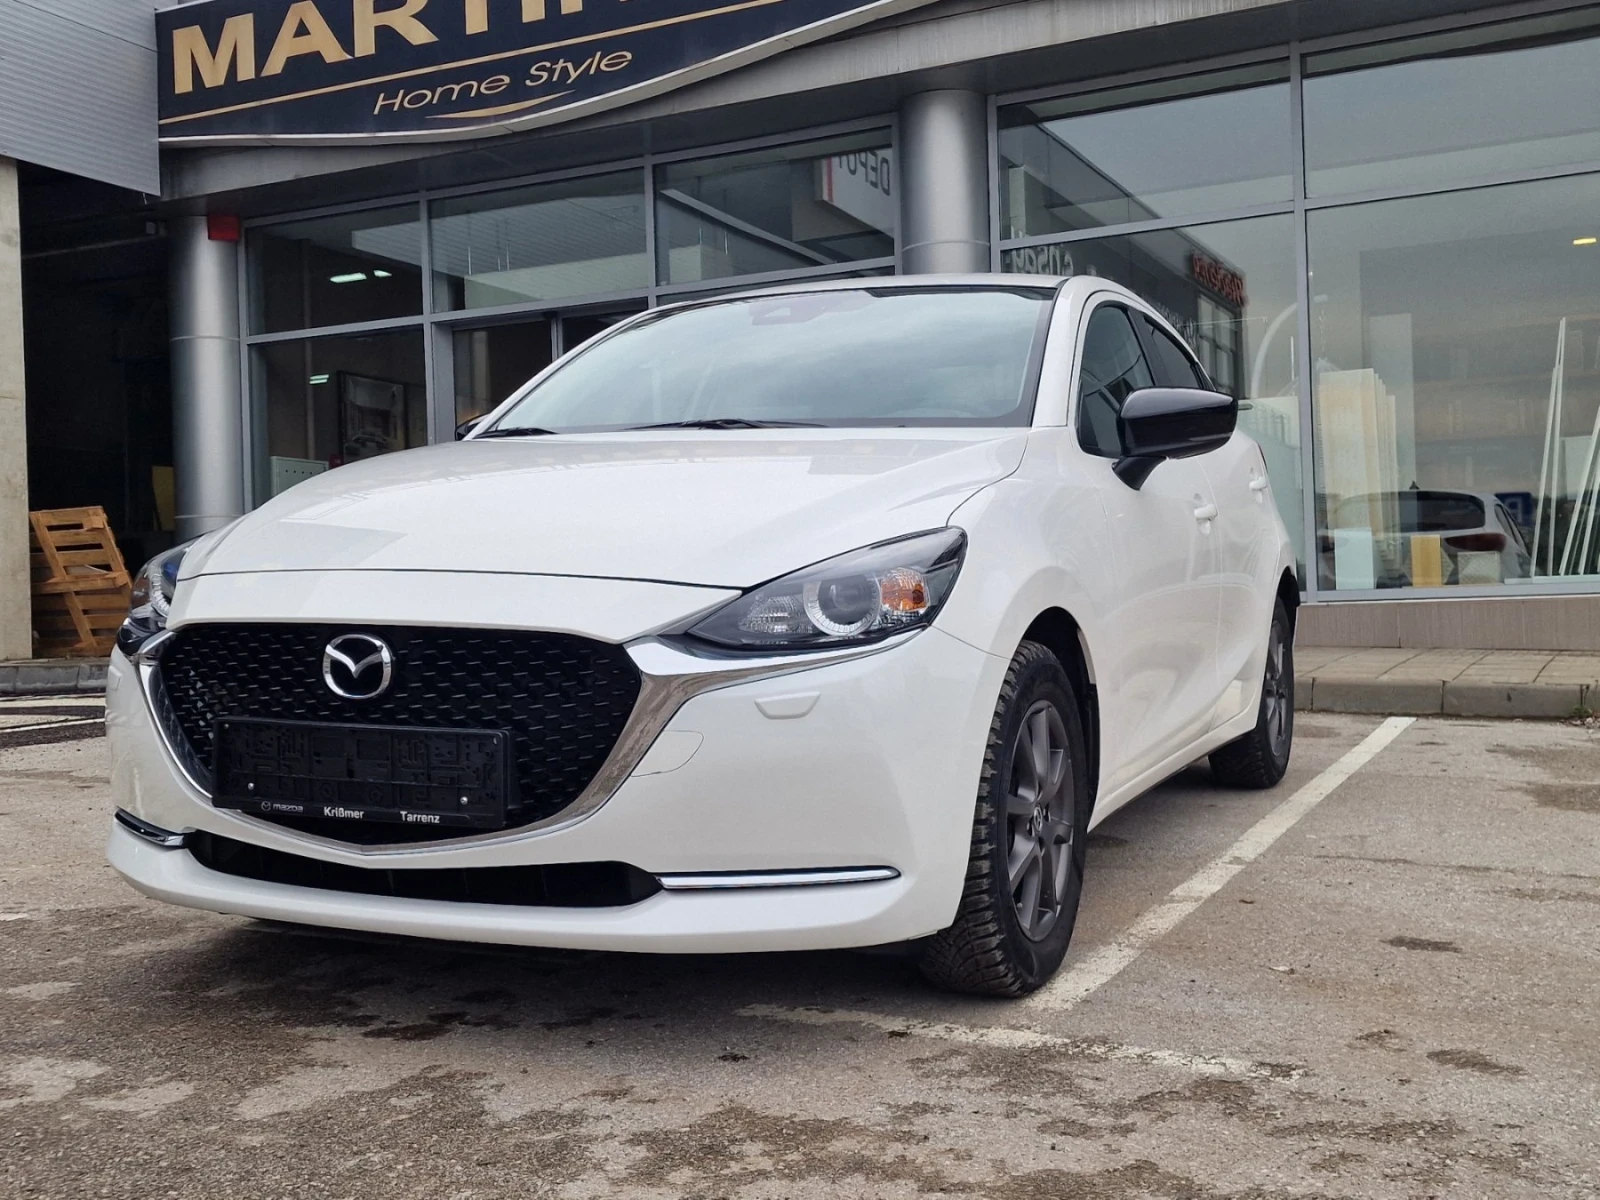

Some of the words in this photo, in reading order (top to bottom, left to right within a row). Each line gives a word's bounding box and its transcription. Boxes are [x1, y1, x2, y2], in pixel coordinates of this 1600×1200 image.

[372, 74, 511, 116] Home
[525, 50, 633, 87] Style
[323, 806, 365, 820] Krißmer
[400, 811, 441, 824] Tarrenz
